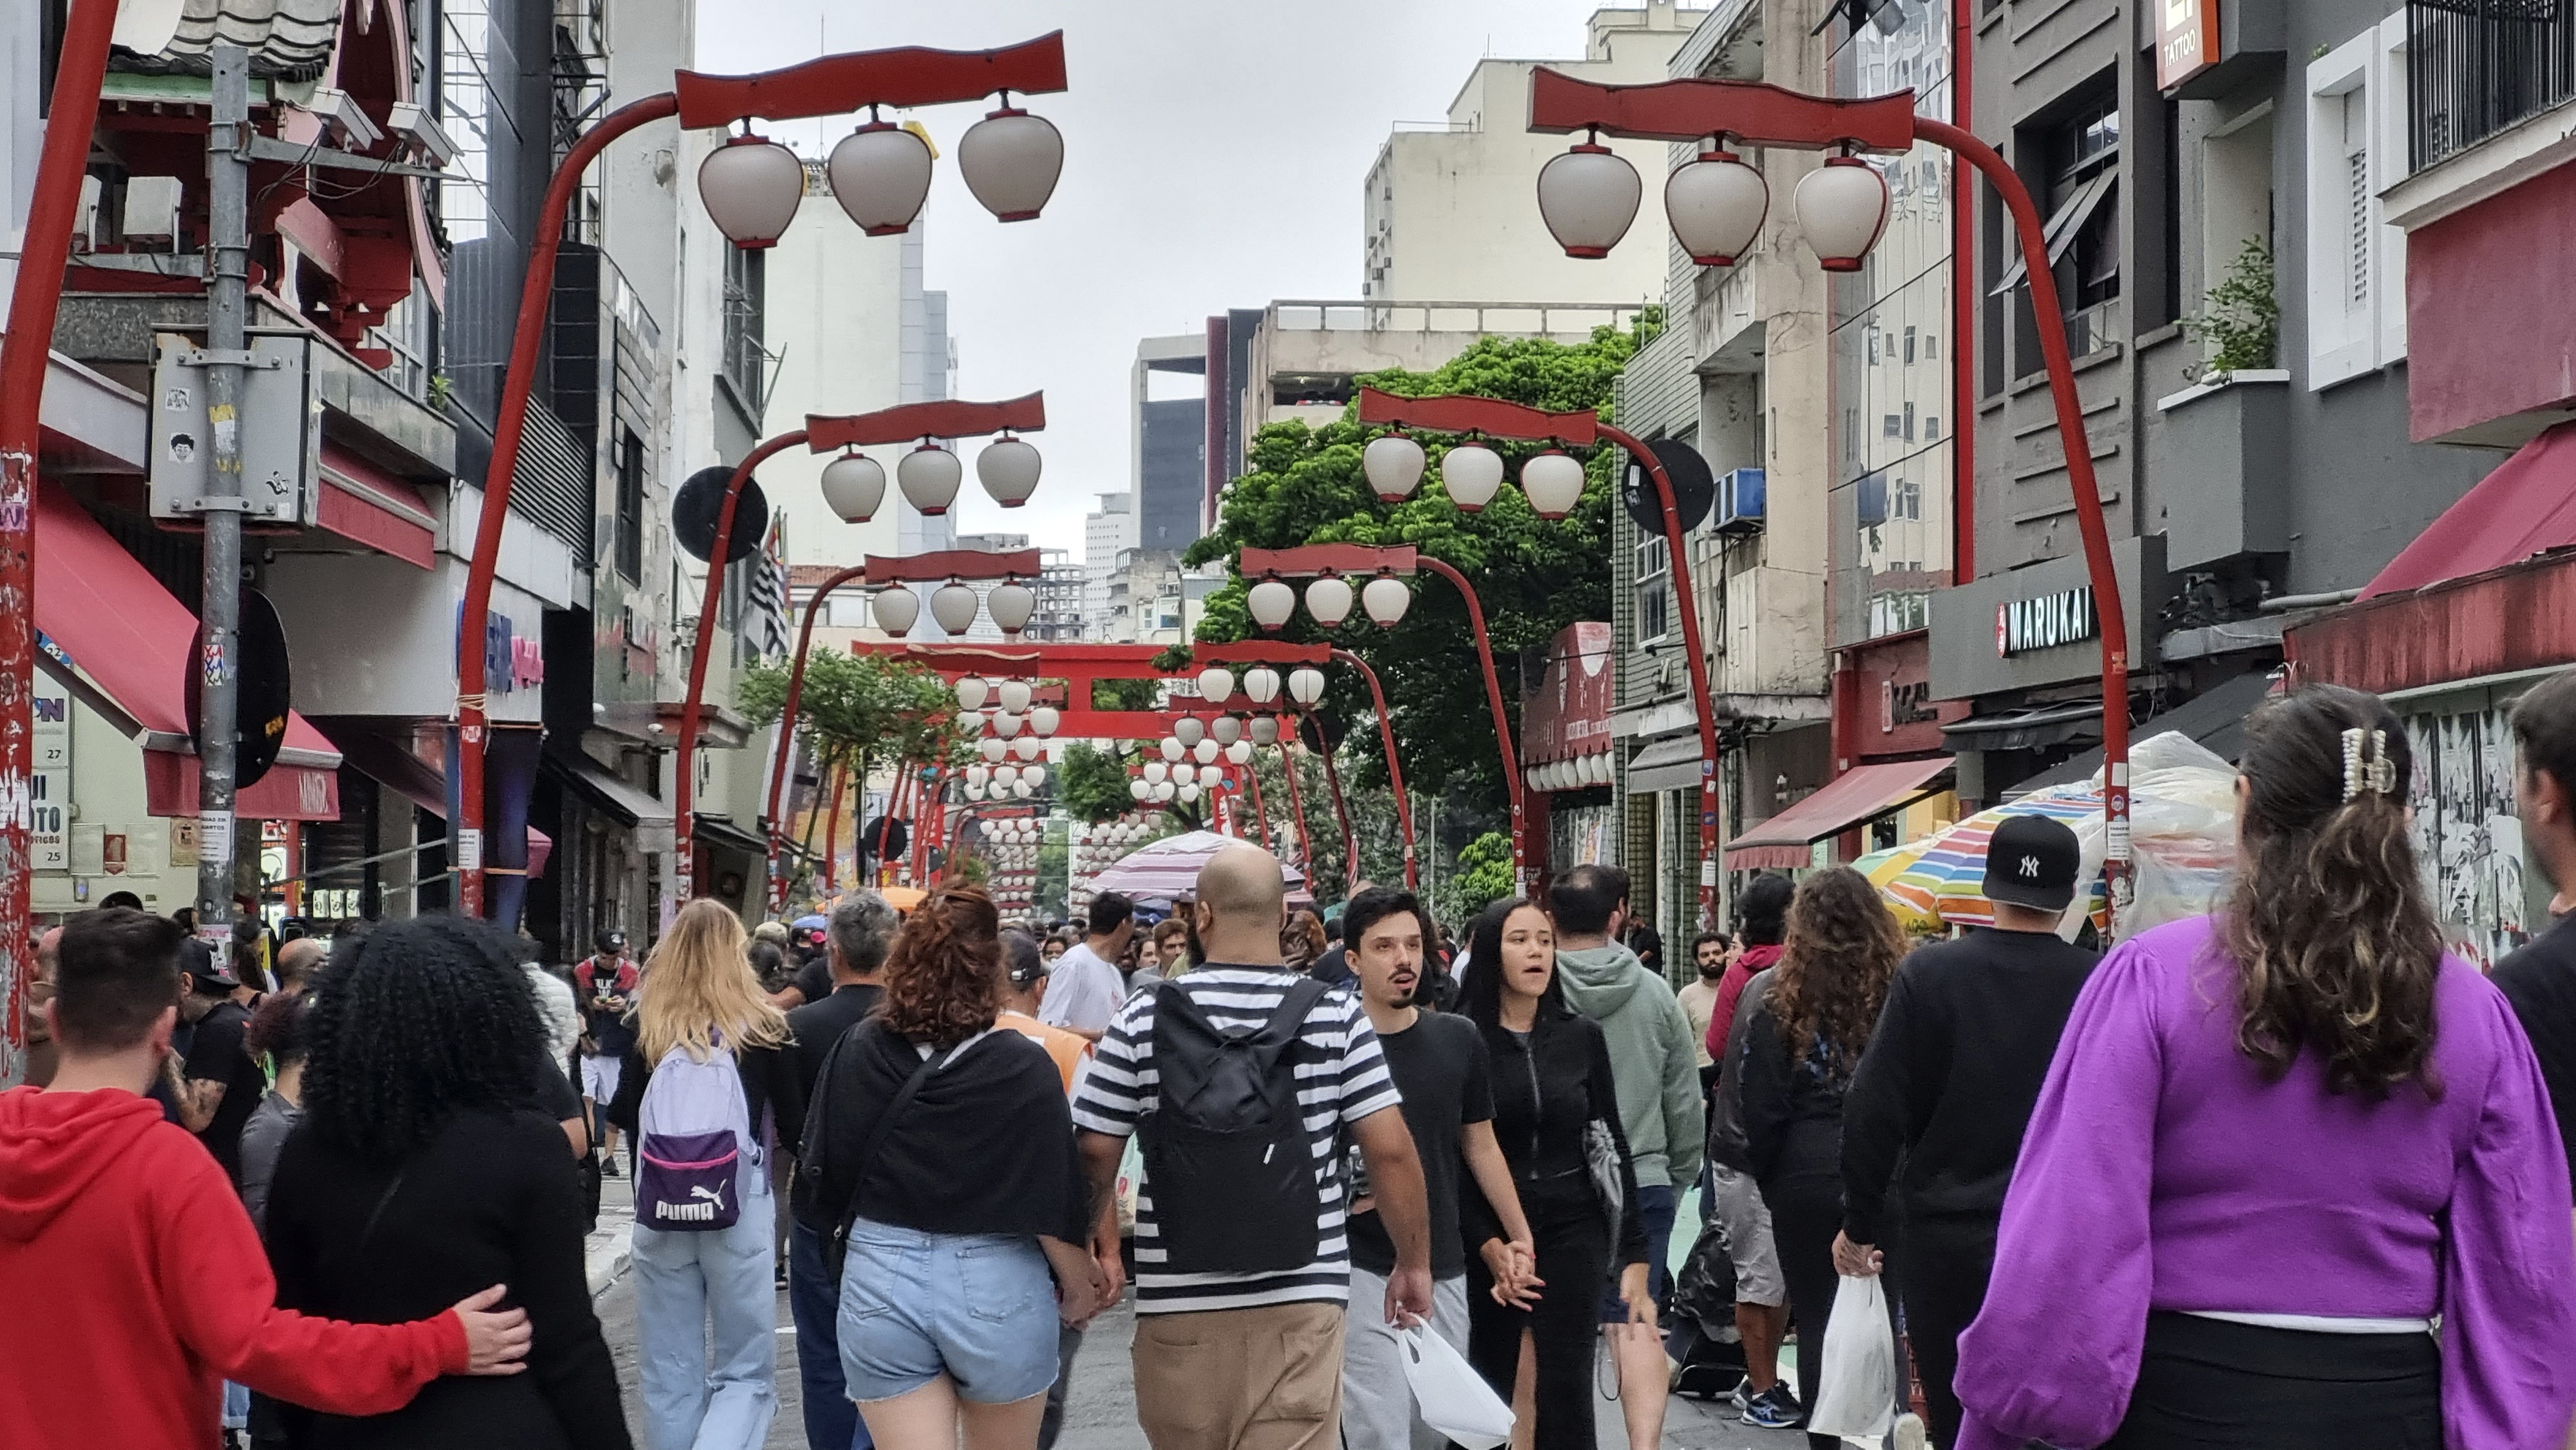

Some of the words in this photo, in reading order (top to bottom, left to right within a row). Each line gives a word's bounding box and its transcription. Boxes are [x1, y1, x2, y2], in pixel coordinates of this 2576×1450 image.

[2164, 28, 2195, 68] TATTOO
[2009, 585, 2089, 651] MARUKAI
[47, 750, 61, 758] 27
[47, 852, 61, 861] 25
[656, 1200, 714, 1221] PUMA
